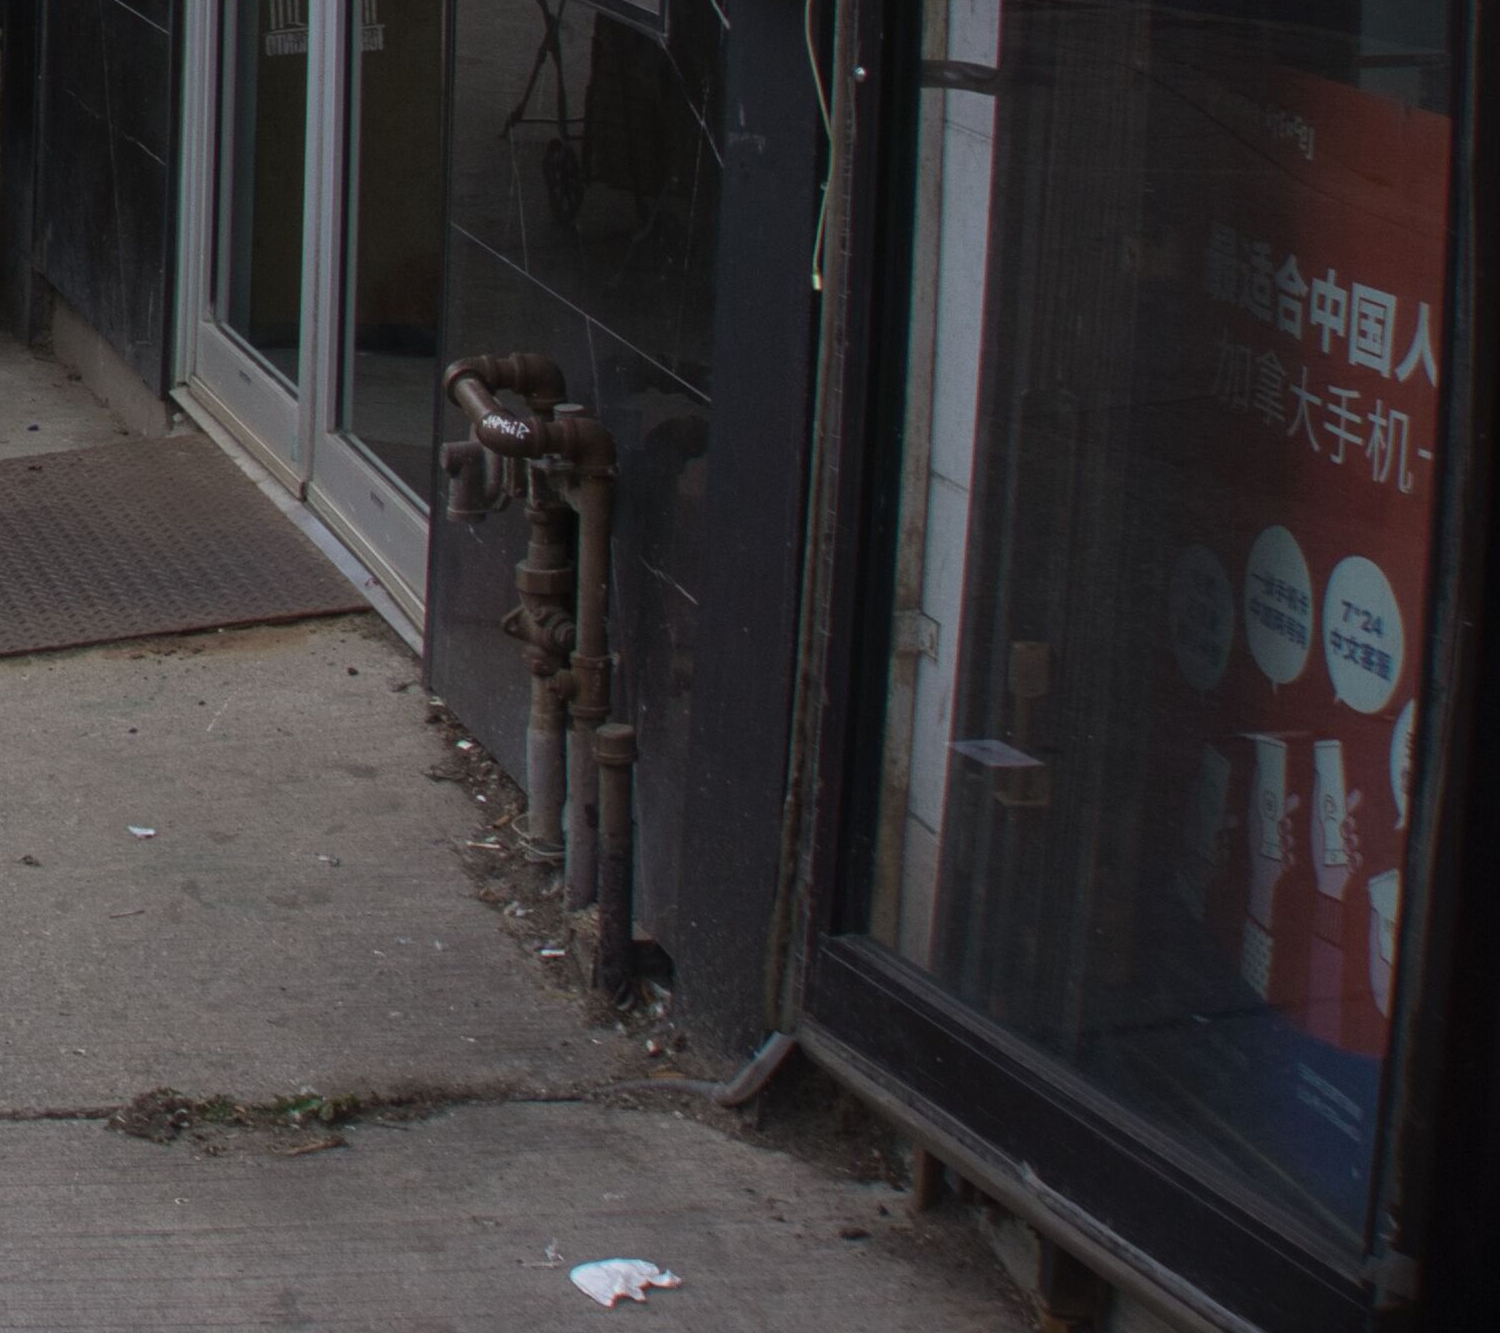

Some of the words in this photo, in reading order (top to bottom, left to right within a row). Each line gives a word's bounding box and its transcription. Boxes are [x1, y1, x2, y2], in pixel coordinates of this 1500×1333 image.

[1212, 331, 1433, 495] 加拿大手机
